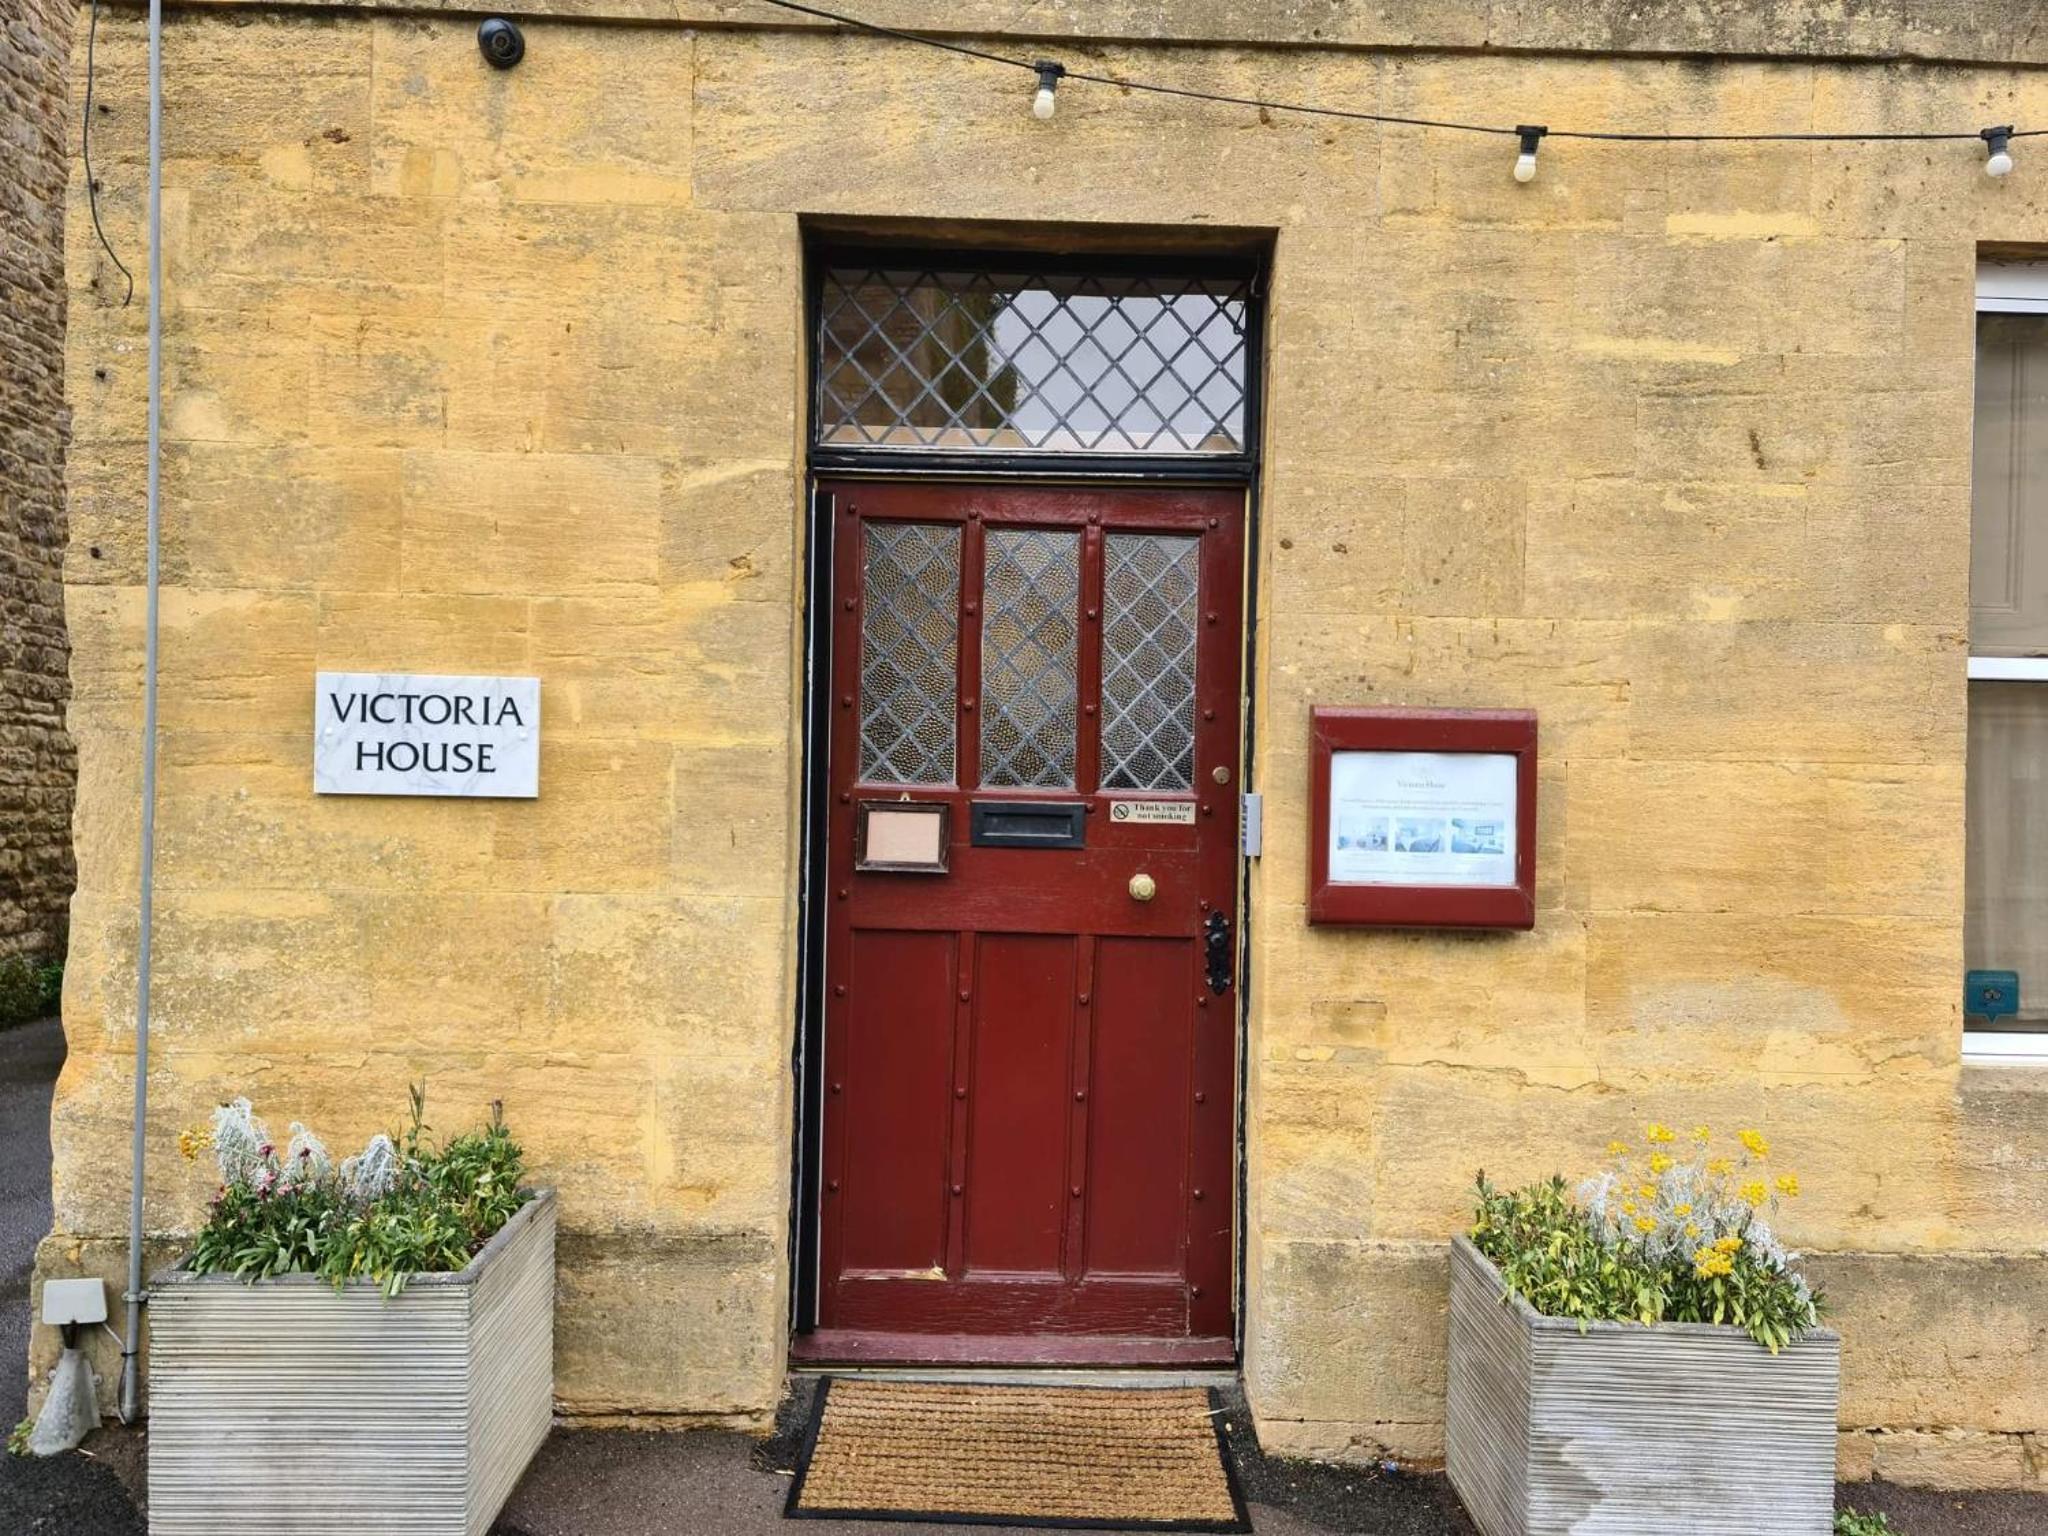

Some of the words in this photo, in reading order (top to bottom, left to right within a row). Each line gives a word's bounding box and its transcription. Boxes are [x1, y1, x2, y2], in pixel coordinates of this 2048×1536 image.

[330, 693, 524, 726] VICTORIA
[356, 741, 496, 773] HOUSE
[1135, 803, 1160, 811] Thank
[1162, 805, 1177, 813] you
[1179, 804, 1191, 812] for
[1152, 812, 1187, 821] smoking
